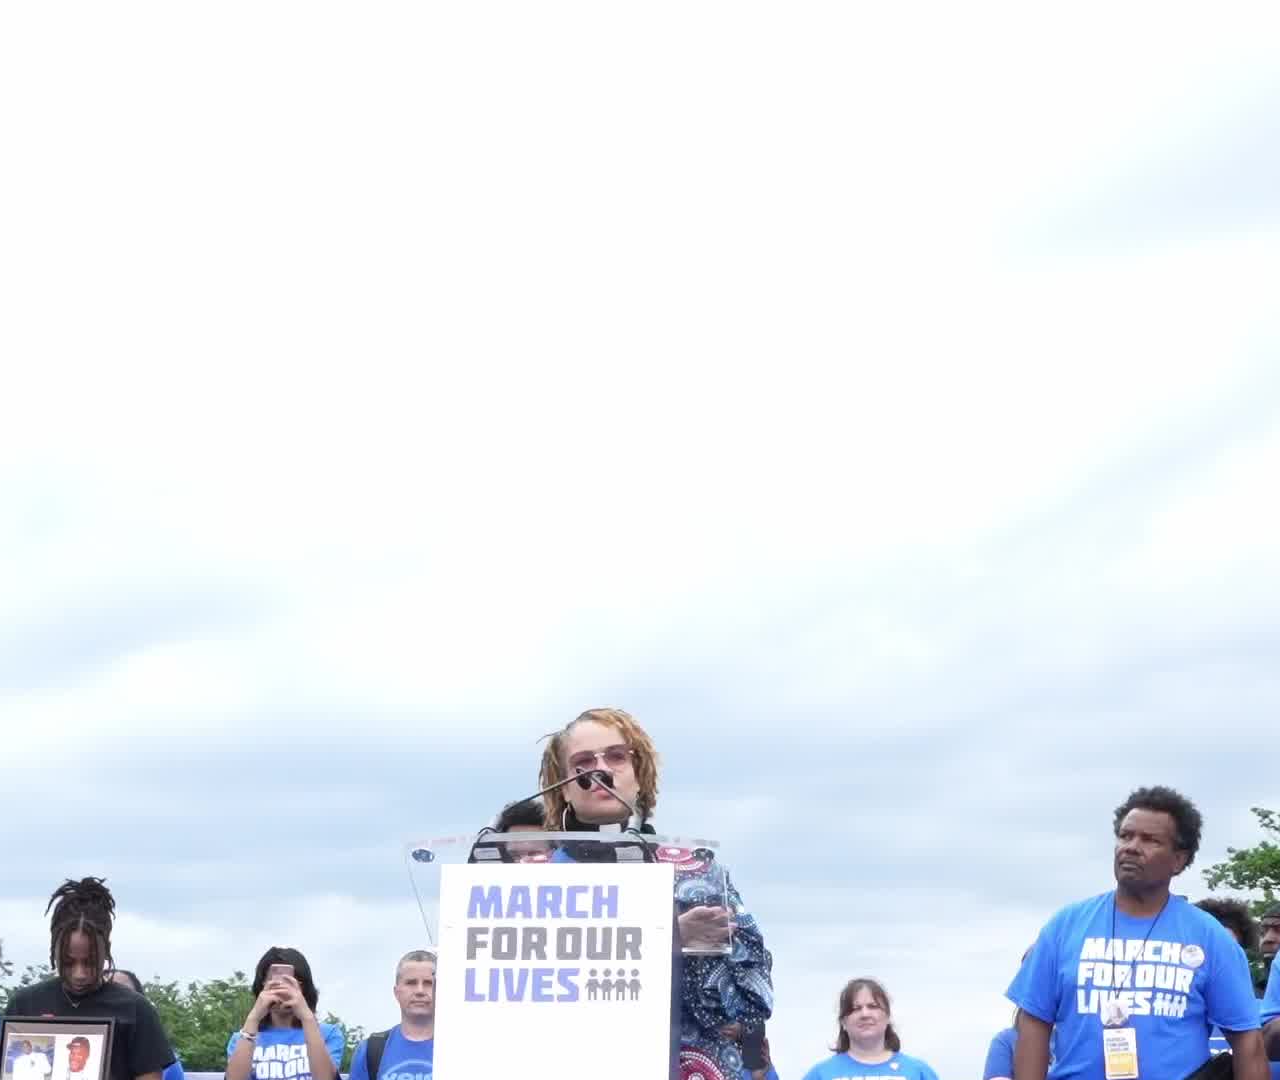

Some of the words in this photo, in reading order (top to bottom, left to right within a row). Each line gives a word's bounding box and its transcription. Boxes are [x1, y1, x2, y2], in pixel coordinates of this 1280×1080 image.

[467, 885, 618, 919] MARCH
[466, 926, 553, 961] FOR
[556, 926, 642, 961] OUR
[1079, 937, 1182, 964] MARCH
[464, 968, 579, 1003] LIVES
[1077, 961, 1133, 989] FOR
[1135, 964, 1194, 994] OUR
[256, 1060, 284, 1079] OR
[285, 1057, 310, 1078] OU
